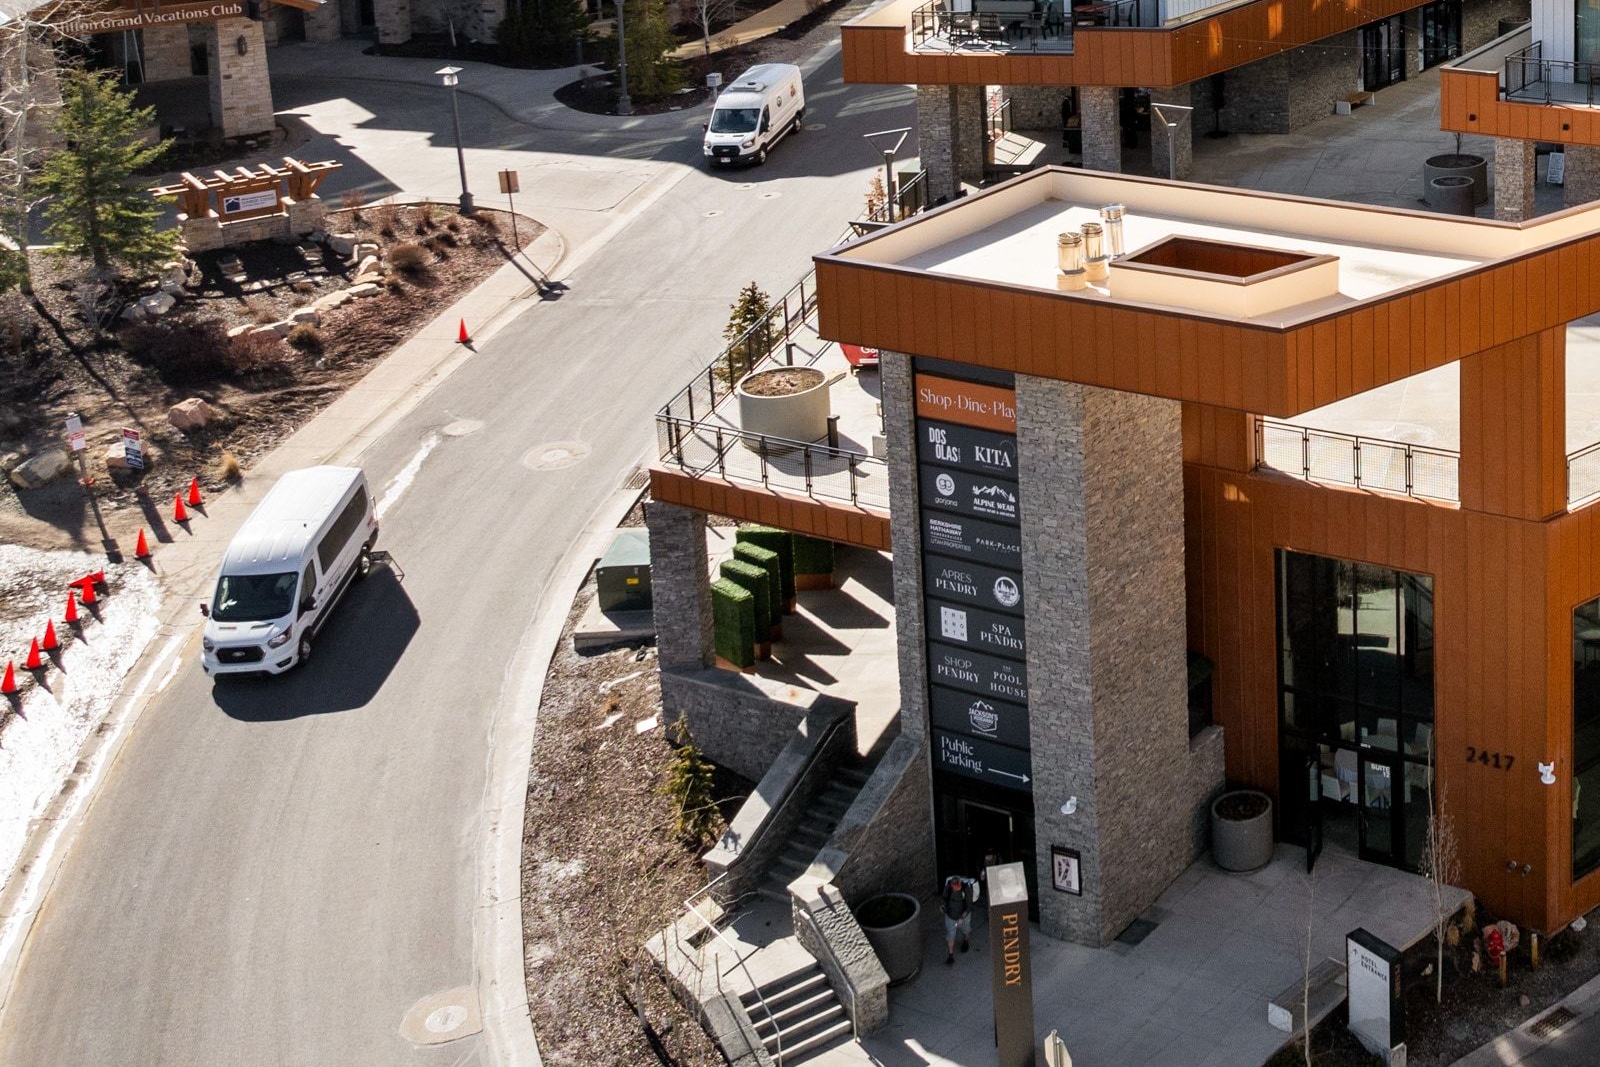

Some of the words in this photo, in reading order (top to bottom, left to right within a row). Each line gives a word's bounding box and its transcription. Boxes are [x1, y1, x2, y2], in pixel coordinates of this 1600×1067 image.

[100, 13, 143, 29] Grand
[145, 8, 209, 24] Vacations
[211, 3, 242, 16] Club
[920, 388, 952, 410] Shop
[958, 394, 987, 414] Dine
[929, 427, 947, 445] DOS
[935, 445, 958, 462] OLAS
[975, 445, 1012, 467] KITA
[973, 497, 996, 509] ALPINE
[996, 502, 1015, 512] WEAR
[929, 518, 962, 531] BERKSHIRE
[930, 525, 962, 535] HATHAWAY
[931, 538, 944, 546] UTAH
[943, 540, 971, 552] PROPERTIES
[936, 578, 978, 596] PENDRY
[992, 623, 1012, 636] SPA
[980, 631, 1024, 650] PENDRY
[944, 655, 972, 669] SHOP
[937, 664, 979, 683] PENDRY
[993, 671, 1022, 685] POOL
[990, 682, 1027, 698] HOUSE
[942, 736, 974, 755] Public
[943, 749, 983, 773] Parking
[1371, 763, 1390, 772] SUITE
[1466, 746, 1515, 771] 2417
[1002, 913, 1021, 986] PENDRY
[1361, 955, 1378, 968] HOTEL
[1361, 961, 1387, 982] ENTRANCE
